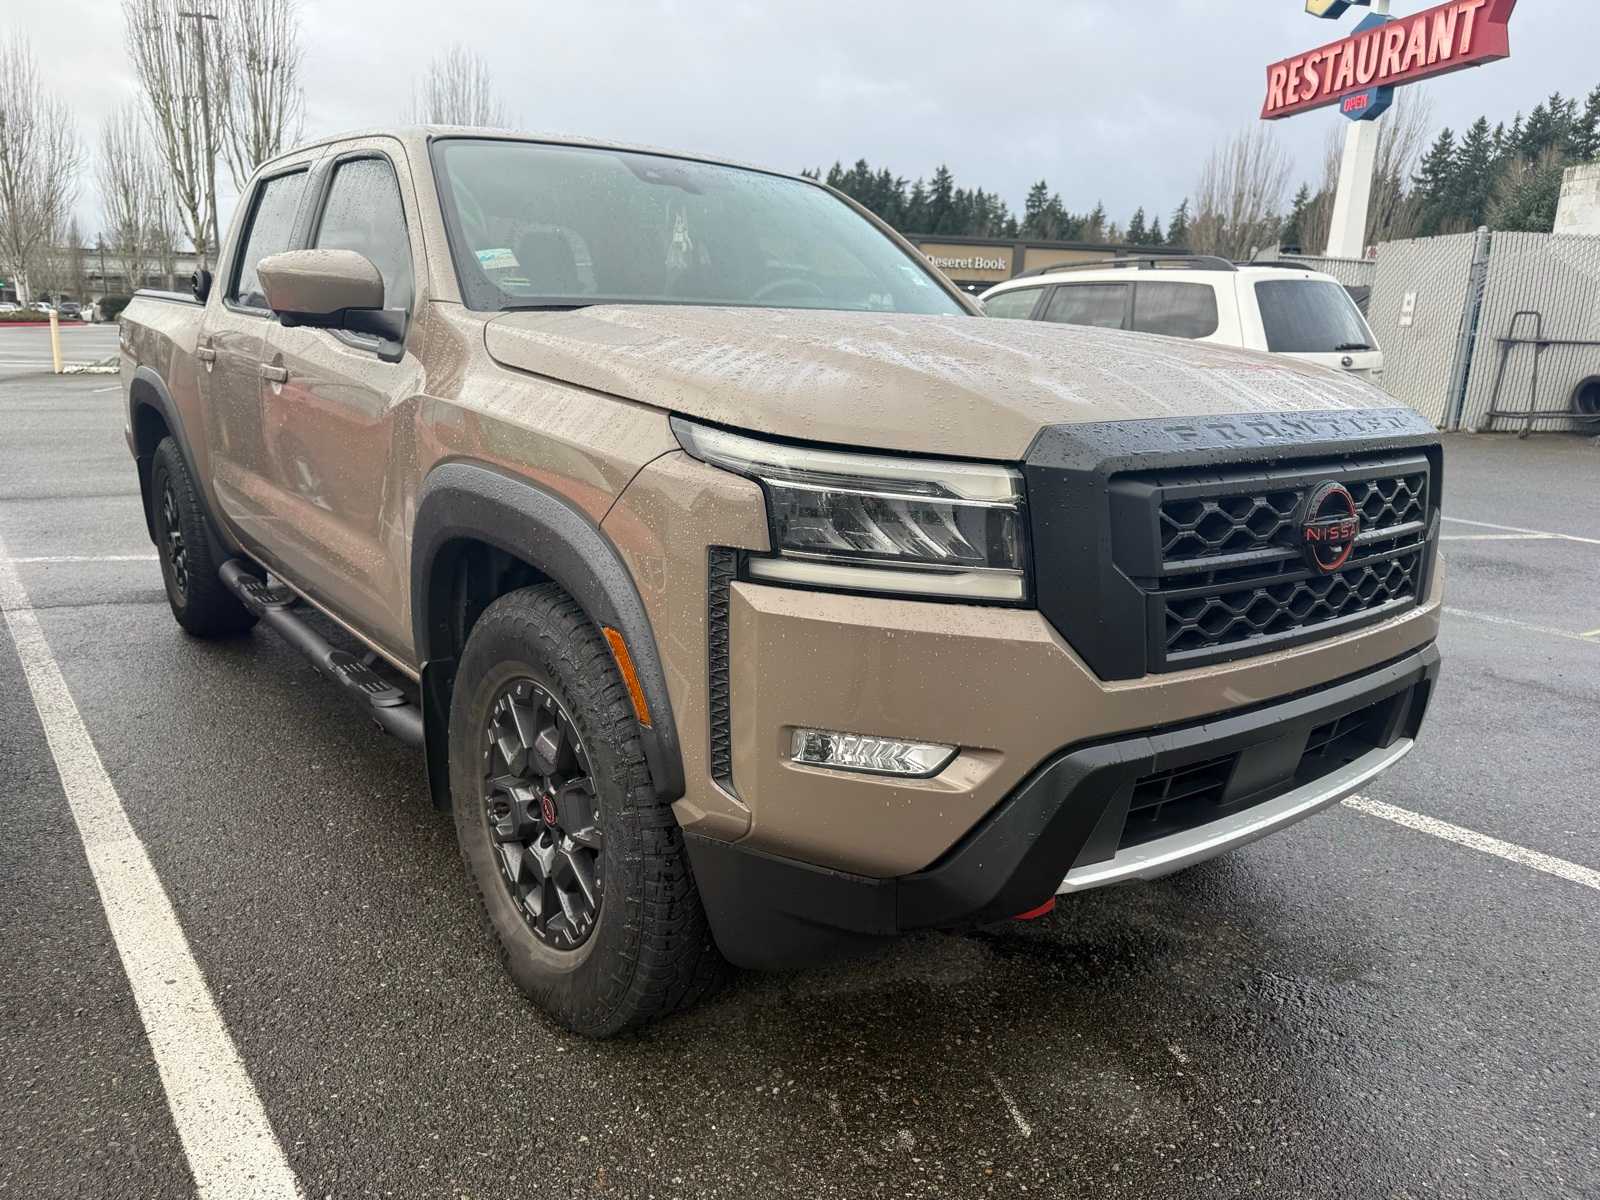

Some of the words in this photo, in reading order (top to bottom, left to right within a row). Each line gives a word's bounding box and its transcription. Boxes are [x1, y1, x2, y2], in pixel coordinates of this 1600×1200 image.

[1267, 0, 1485, 110] RESTAURANT
[1343, 94, 1368, 112] OPEN
[974, 256, 1006, 270] Book
[1306, 524, 1357, 541] NISSA
